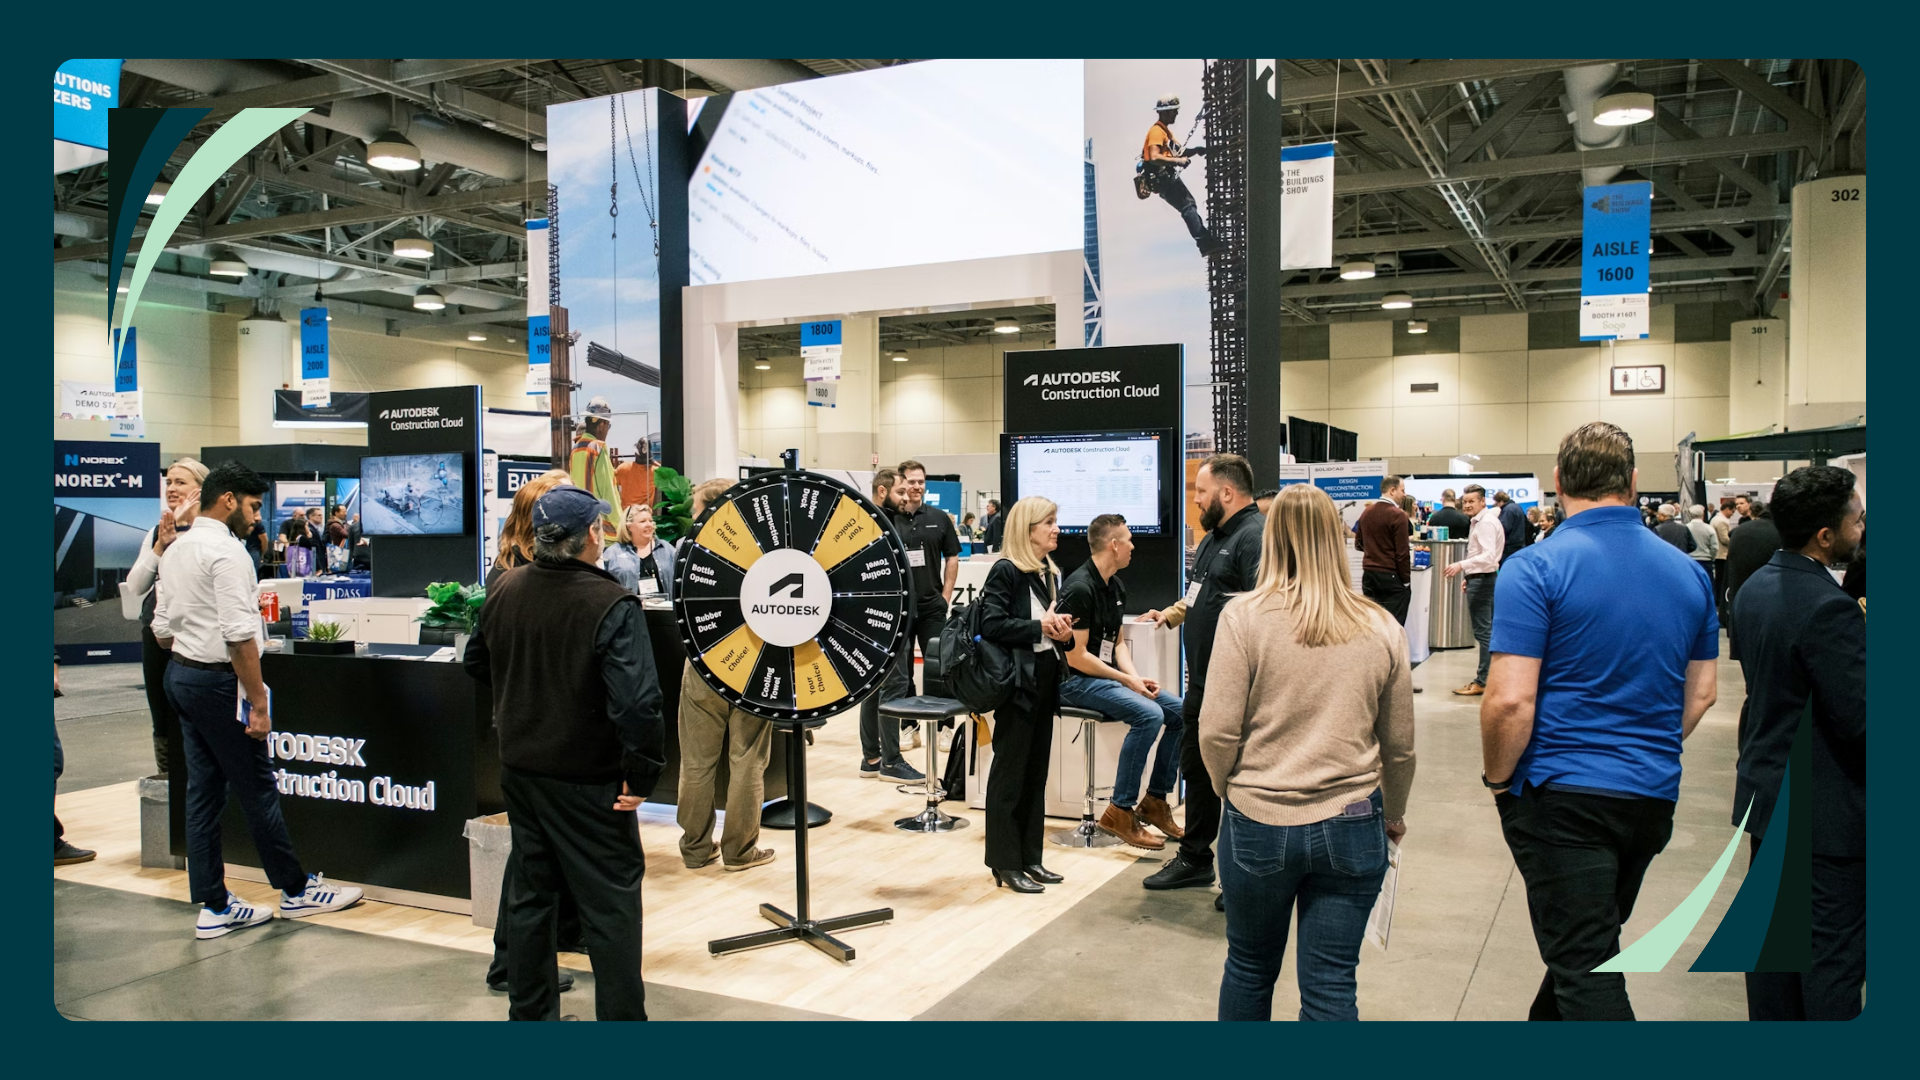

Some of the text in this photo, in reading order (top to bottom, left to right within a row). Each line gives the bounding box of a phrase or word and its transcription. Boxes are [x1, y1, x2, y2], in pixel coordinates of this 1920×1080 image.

[54, 71, 111, 98] UTIONS
[800, 99, 824, 120] Project
[1286, 169, 1301, 177] THE
[1286, 175, 1324, 186] BUILDINGS
[1286, 186, 1308, 195] SHOW
[1831, 188, 1860, 202] 302
[1592, 240, 1640, 257] AISLE
[1597, 266, 1634, 282] 1600
[1592, 312, 1615, 320] BOOTH
[811, 323, 833, 336] 1800
[1751, 327, 1768, 335] 301
[306, 344, 325, 354] AISLE
[307, 360, 324, 371] 2000
[120, 375, 133, 385] 2100
[1041, 371, 1121, 386] AUTODESK
[815, 388, 828, 398] 1800
[1041, 384, 1160, 401] Construction Cloud
[75, 399, 100, 408] DEMO
[391, 407, 440, 419] AUTODESK
[119, 423, 135, 431] 2100
[391, 417, 464, 431] Construction Cloud
[800, 488, 810, 508] Duck
[808, 489, 820, 520] Rubber
[752, 497, 765, 523] Pencil
[760, 494, 780, 546] Construction
[723, 520, 738, 537] Your
[833, 518, 857, 543] Choice!
[848, 525, 864, 541] Your
[716, 528, 740, 552] Choice!
[692, 563, 715, 576] Bottle
[865, 558, 889, 571] Towel
[689, 573, 717, 586] Opener
[861, 567, 891, 582] Cooling
[337, 588, 360, 598] DASS
[695, 610, 722, 624] Rubber
[751, 604, 820, 616] AUTODESK
[865, 607, 894, 621] Opener
[698, 622, 718, 633] Duck
[867, 618, 891, 631] Bottle
[720, 649, 735, 665] Your
[728, 646, 750, 672] Choice!
[828, 636, 867, 677] Construction
[852, 648, 874, 670] Pencil
[761, 666, 775, 698] Cooling
[812, 662, 825, 692] Choice!
[770, 676, 781, 700] Towel
[807, 676, 816, 695] Your
[369, 776, 435, 811] Cloud
